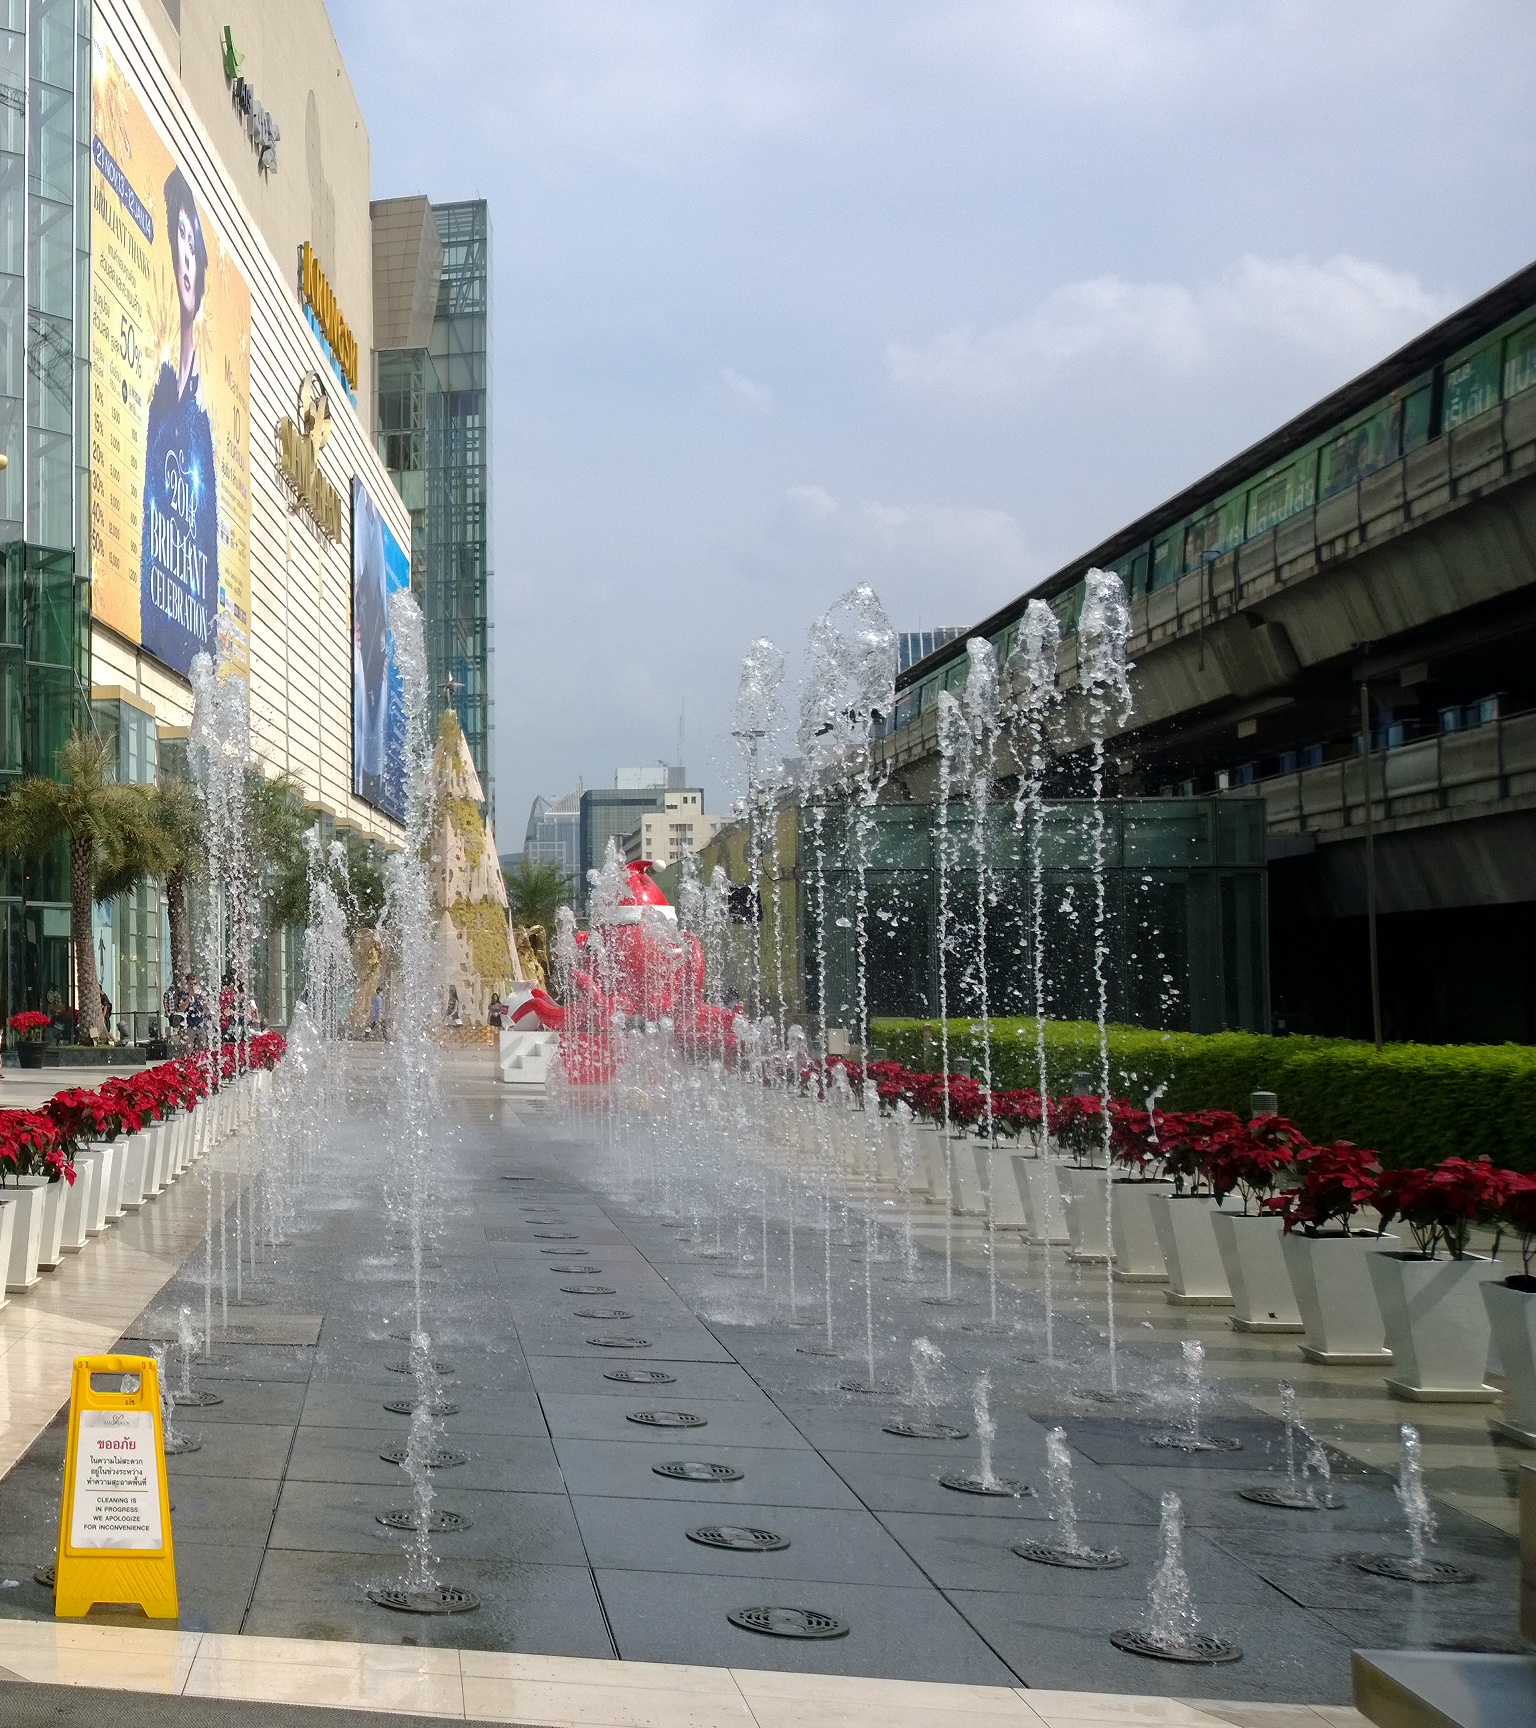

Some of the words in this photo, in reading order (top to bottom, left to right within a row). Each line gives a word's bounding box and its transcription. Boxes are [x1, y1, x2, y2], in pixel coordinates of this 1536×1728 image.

[93, 184, 127, 248] BRILLIANT
[126, 230, 151, 281] THANKS
[119, 314, 142, 379] 50%
[93, 382, 104, 408] 10%
[233, 404, 240, 444] 10
[92, 440, 105, 468] 20%
[92, 468, 105, 497] 30%
[92, 499, 105, 527] 40%
[92, 528, 105, 557] 50%
[150, 500, 208, 600] BRILLIANT
[150, 565, 209, 643] CELEBRATION
[96, 1436, 136, 1450] ขออภัย
[89, 1455, 144, 1465] ในความไม่สะดวก
[90, 1466, 143, 1477] อยู่ในช่วงระหว่าง
[86, 1476, 147, 1486] ทำความสะอาดพื้นที่
[98, 1524, 150, 1532] INCONVENIENCE
